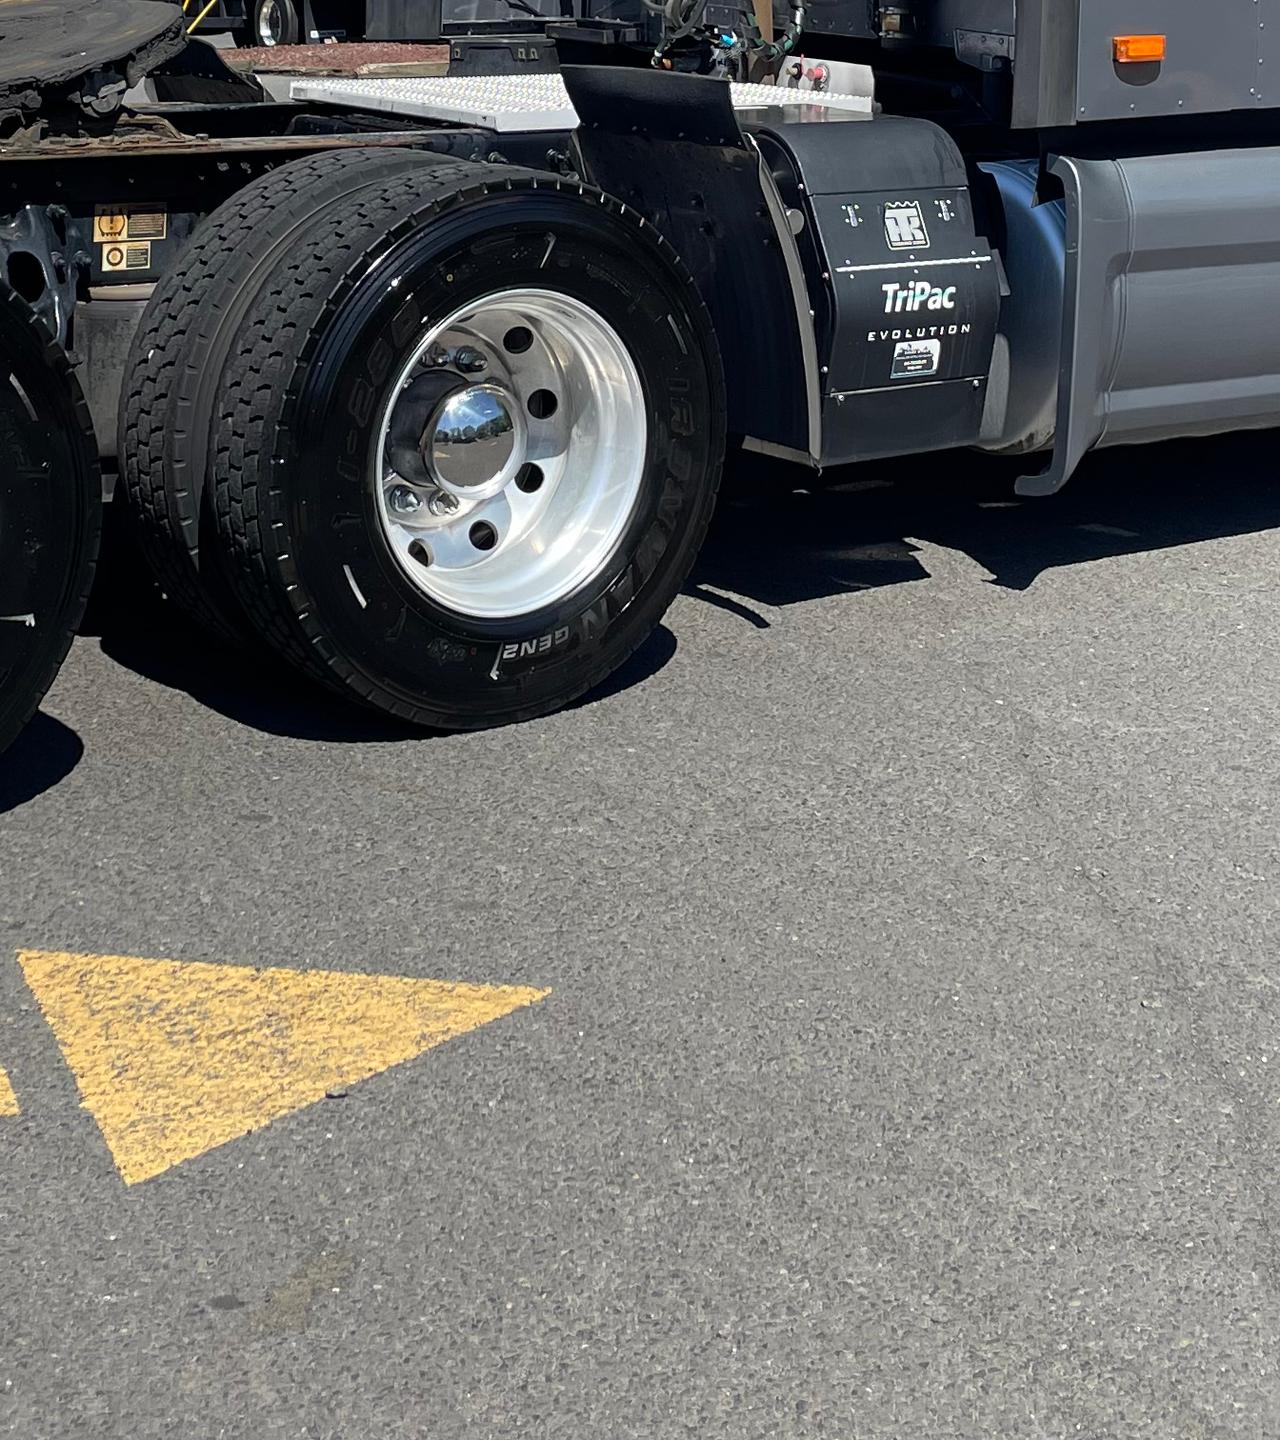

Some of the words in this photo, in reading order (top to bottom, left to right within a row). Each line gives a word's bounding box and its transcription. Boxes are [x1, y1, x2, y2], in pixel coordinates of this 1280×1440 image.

[881, 280, 957, 313] TriPac
[867, 323, 971, 342] EVOLUTION
[502, 625, 569, 660] GEN2
